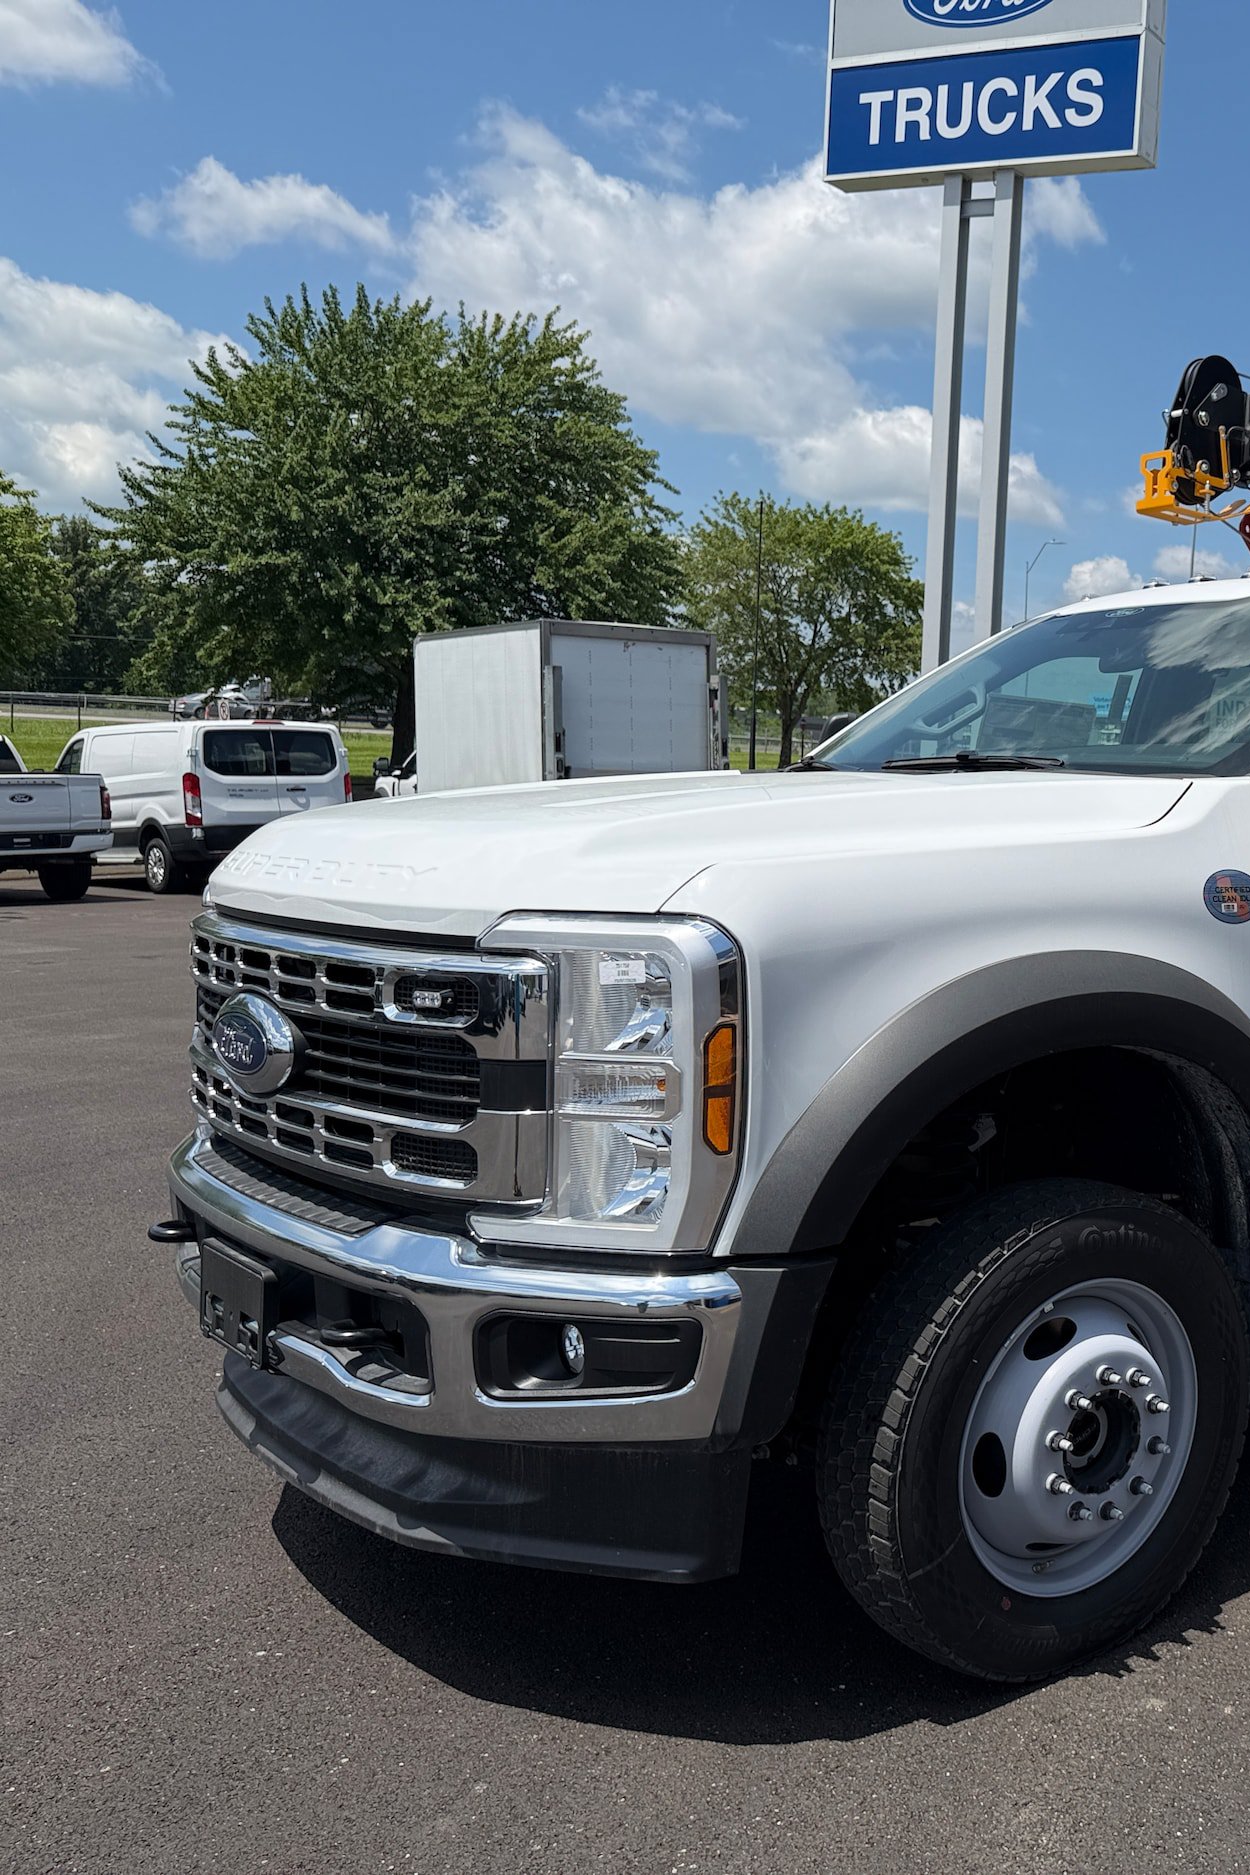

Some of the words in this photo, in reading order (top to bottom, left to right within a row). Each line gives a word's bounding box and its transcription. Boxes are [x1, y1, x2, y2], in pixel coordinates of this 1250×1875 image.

[859, 68, 1104, 145] TRUCKS
[1215, 886, 1250, 894] CERTIFIED
[1212, 895, 1237, 903] CLEAN
